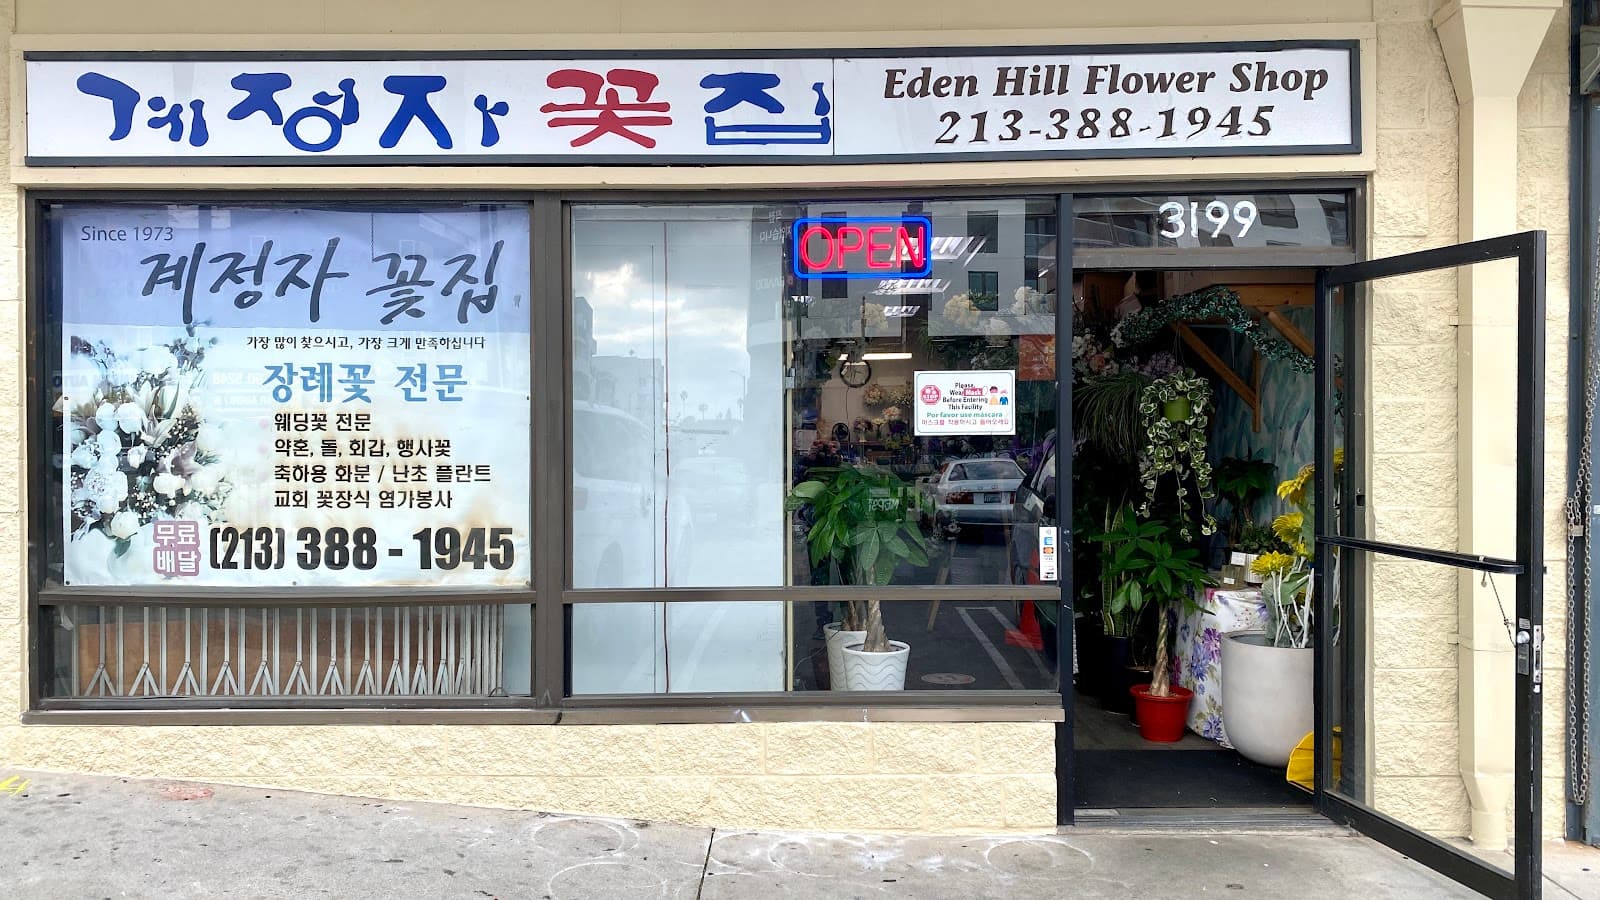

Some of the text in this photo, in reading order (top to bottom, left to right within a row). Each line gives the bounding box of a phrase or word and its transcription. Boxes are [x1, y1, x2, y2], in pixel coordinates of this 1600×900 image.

[884, 61, 1329, 100] Eden Hill Flower Shop
[540, 68, 833, 147] 꽃집
[935, 105, 1275, 144] 213-388-1945
[81, 224, 174, 242] Since 1973
[1158, 200, 1257, 239] 3199
[801, 226, 925, 270] OPEN
[140, 237, 505, 325] 계정자 꽃집
[247, 336, 487, 350] 가장 많이 찾으시고, 가장 크게 만족하십니다
[262, 362, 468, 403] 장례꽃 전문
[274, 413, 371, 432] 웨딩꽃 전문
[275, 439, 451, 458] 약혼, 돌, 회갑, 행사꽃
[274, 465, 491, 483] 축하용 화분 / 난초 플란트
[274, 490, 453, 508] 교회 꽃장식 염가봉사
[156, 524, 198, 545] 무료
[209, 527, 515, 570] (213) 388 - 1945
[156, 550, 198, 573] 배달
